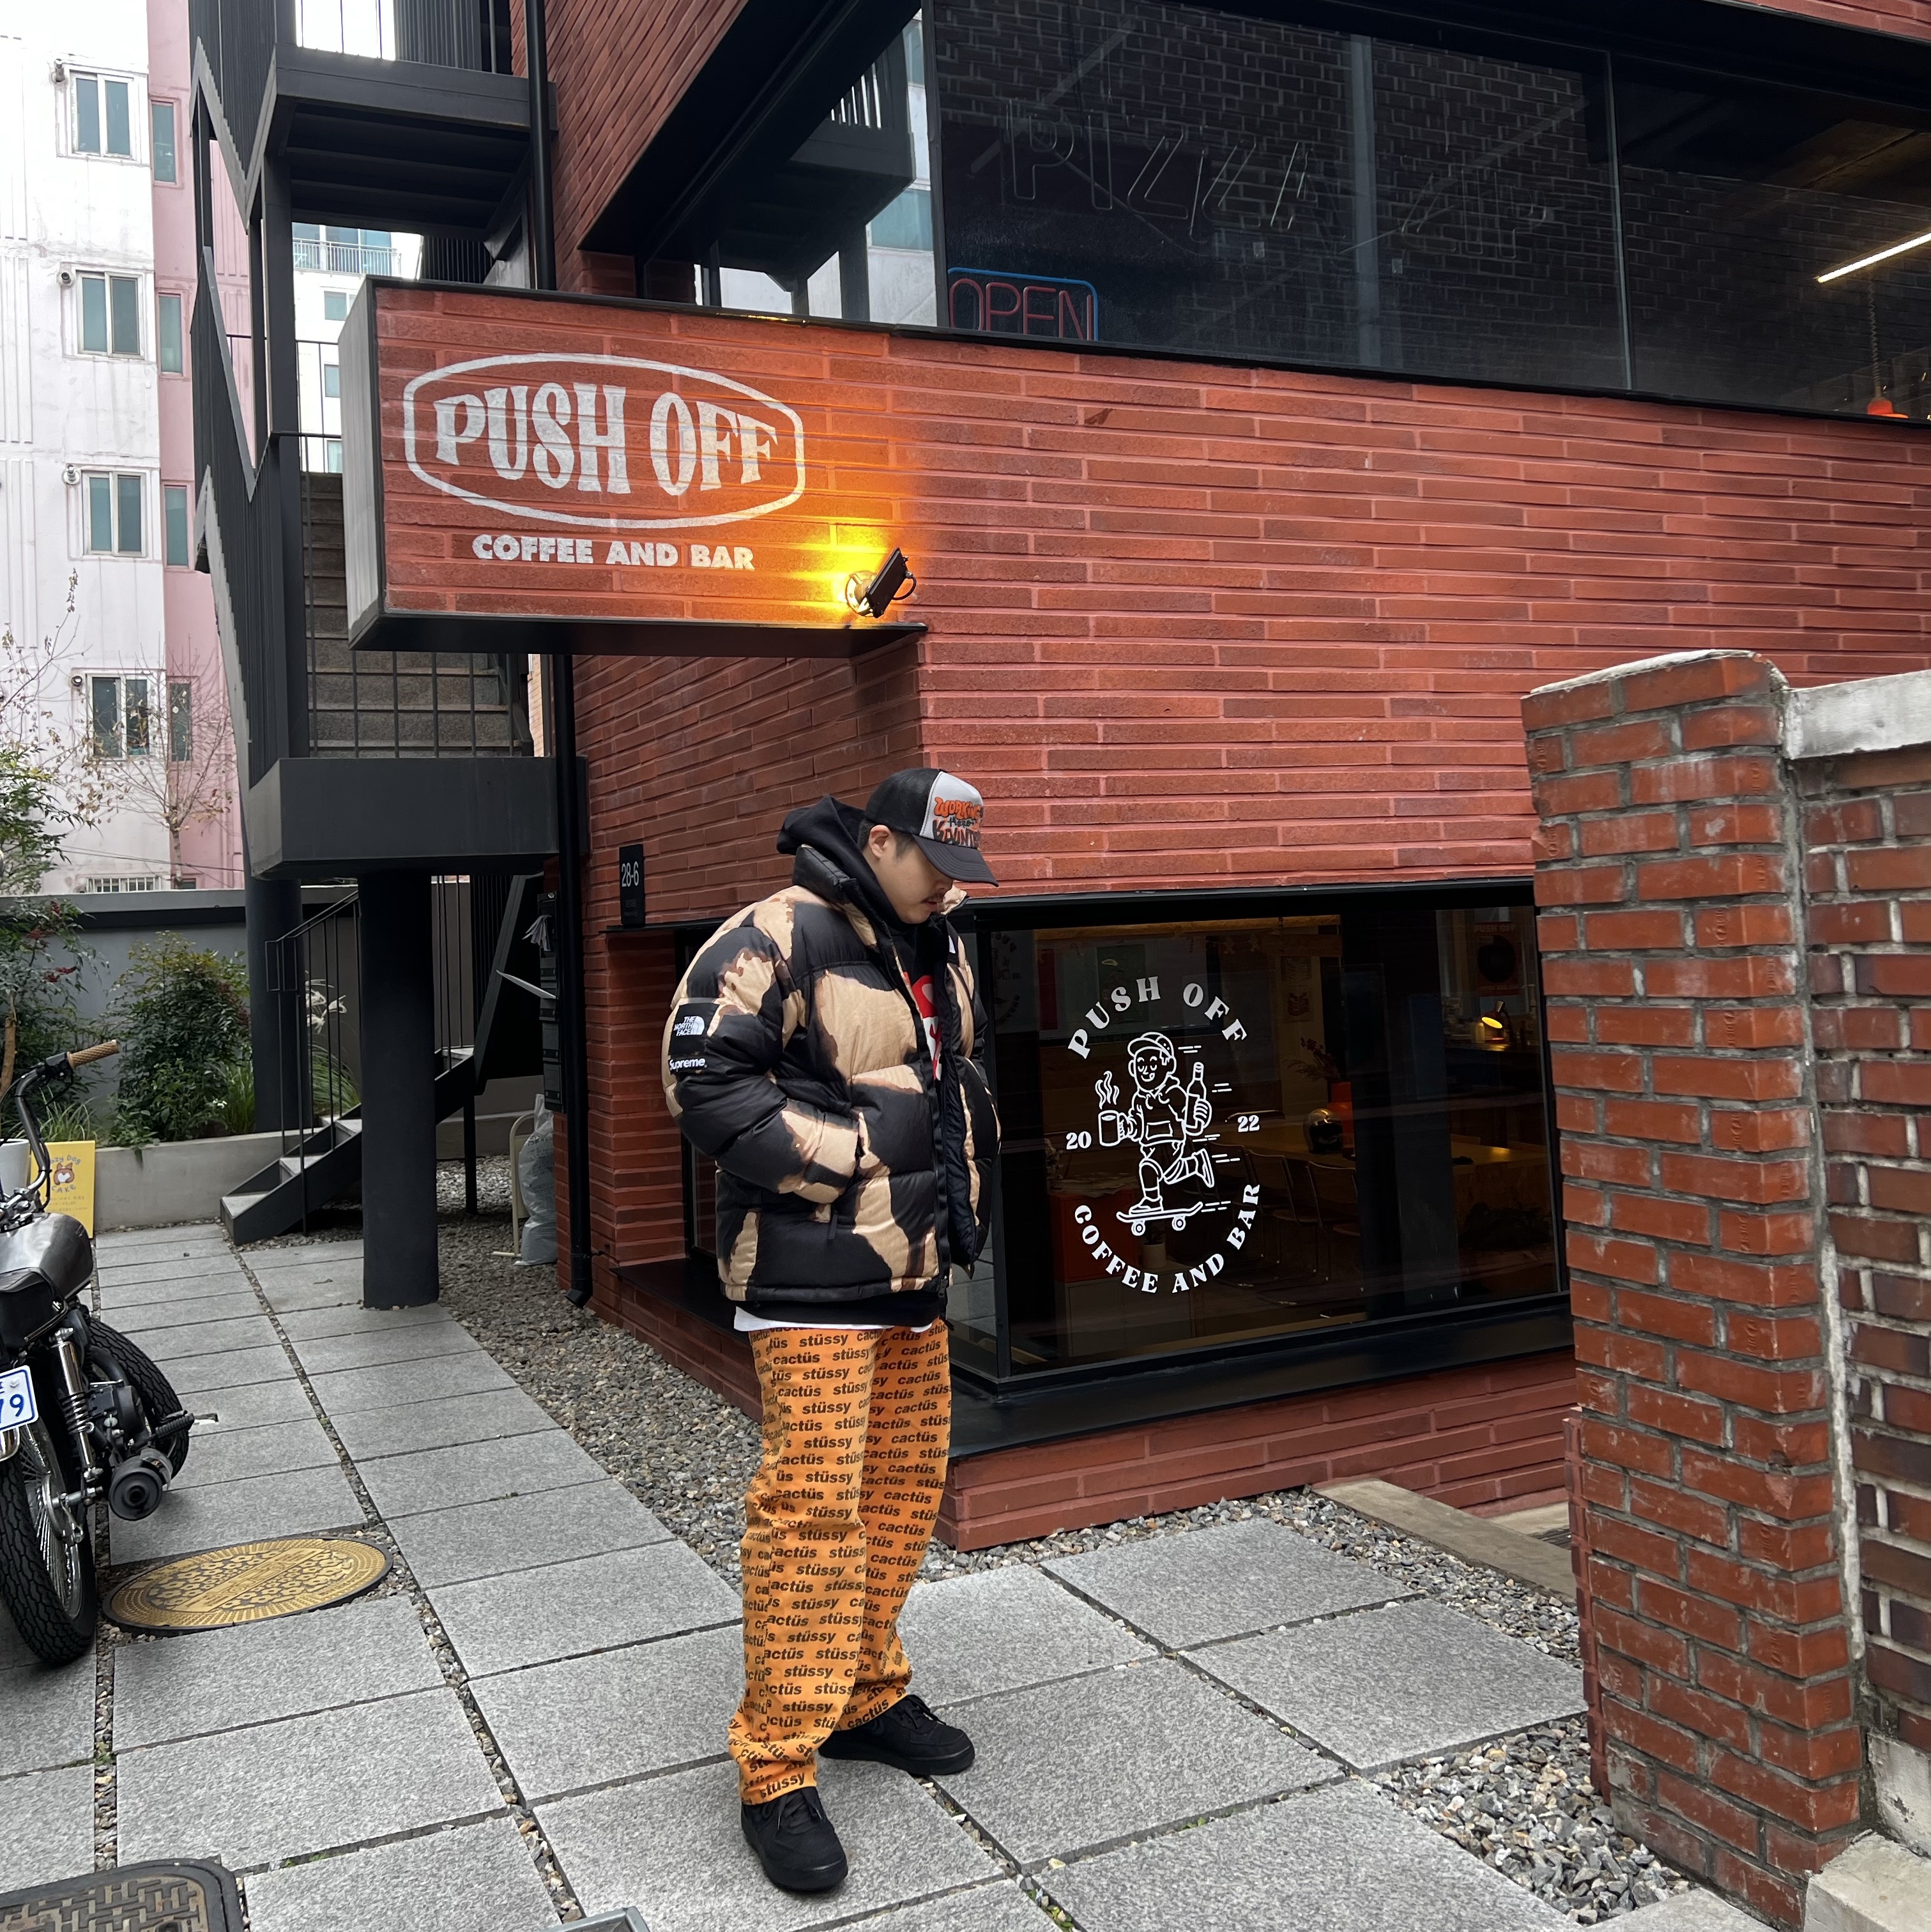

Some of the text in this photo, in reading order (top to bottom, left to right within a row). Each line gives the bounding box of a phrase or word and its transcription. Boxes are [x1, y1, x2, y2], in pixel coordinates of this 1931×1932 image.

[949, 278, 1093, 341] OPEN
[433, 383, 778, 496] PUSH OFF
[471, 535, 754, 571] COFFEE AND BAR
[622, 861, 639, 887] 28-6
[1067, 976, 1161, 1060] PUSH
[1183, 982, 1248, 1041] OFF
[673, 1022, 694, 1031] NORTH
[669, 1058, 706, 1072] Supreme
[1237, 1115, 1260, 1132] 22
[1065, 1131, 1092, 1150] 20
[1074, 1184, 1260, 1293] COFFEE AND BAR
[798, 1334, 849, 1348] stüssy
[901, 1340, 941, 1356] cactüs
[772, 1351, 821, 1365] cactüs
[926, 1353, 949, 1367] stüs
[802, 1367, 850, 1380] stüssy
[897, 1371, 941, 1385] cactüs
[777, 1385, 821, 1397] cactüs
[802, 1401, 851, 1415] stüssy
[894, 1399, 938, 1415] cactüs
[804, 1436, 853, 1450] stüssy
[891, 1431, 938, 1444] cactüs
[888, 1463, 936, 1475] cactüs
[805, 1471, 854, 1486] stüssy
[883, 1491, 932, 1504] cactüs
[805, 1505, 853, 1521] stüssy
[798, 1529, 848, 1543] stüssy
[878, 1522, 926, 1537] cactüs
[870, 1554, 918, 1567] cactüs
[796, 1563, 846, 1578] stüssy
[791, 1598, 840, 1609] stüssy
[786, 1630, 837, 1645] stüssy
[783, 1664, 834, 1679] stüssy
[782, 1701, 834, 1714] stüssy
